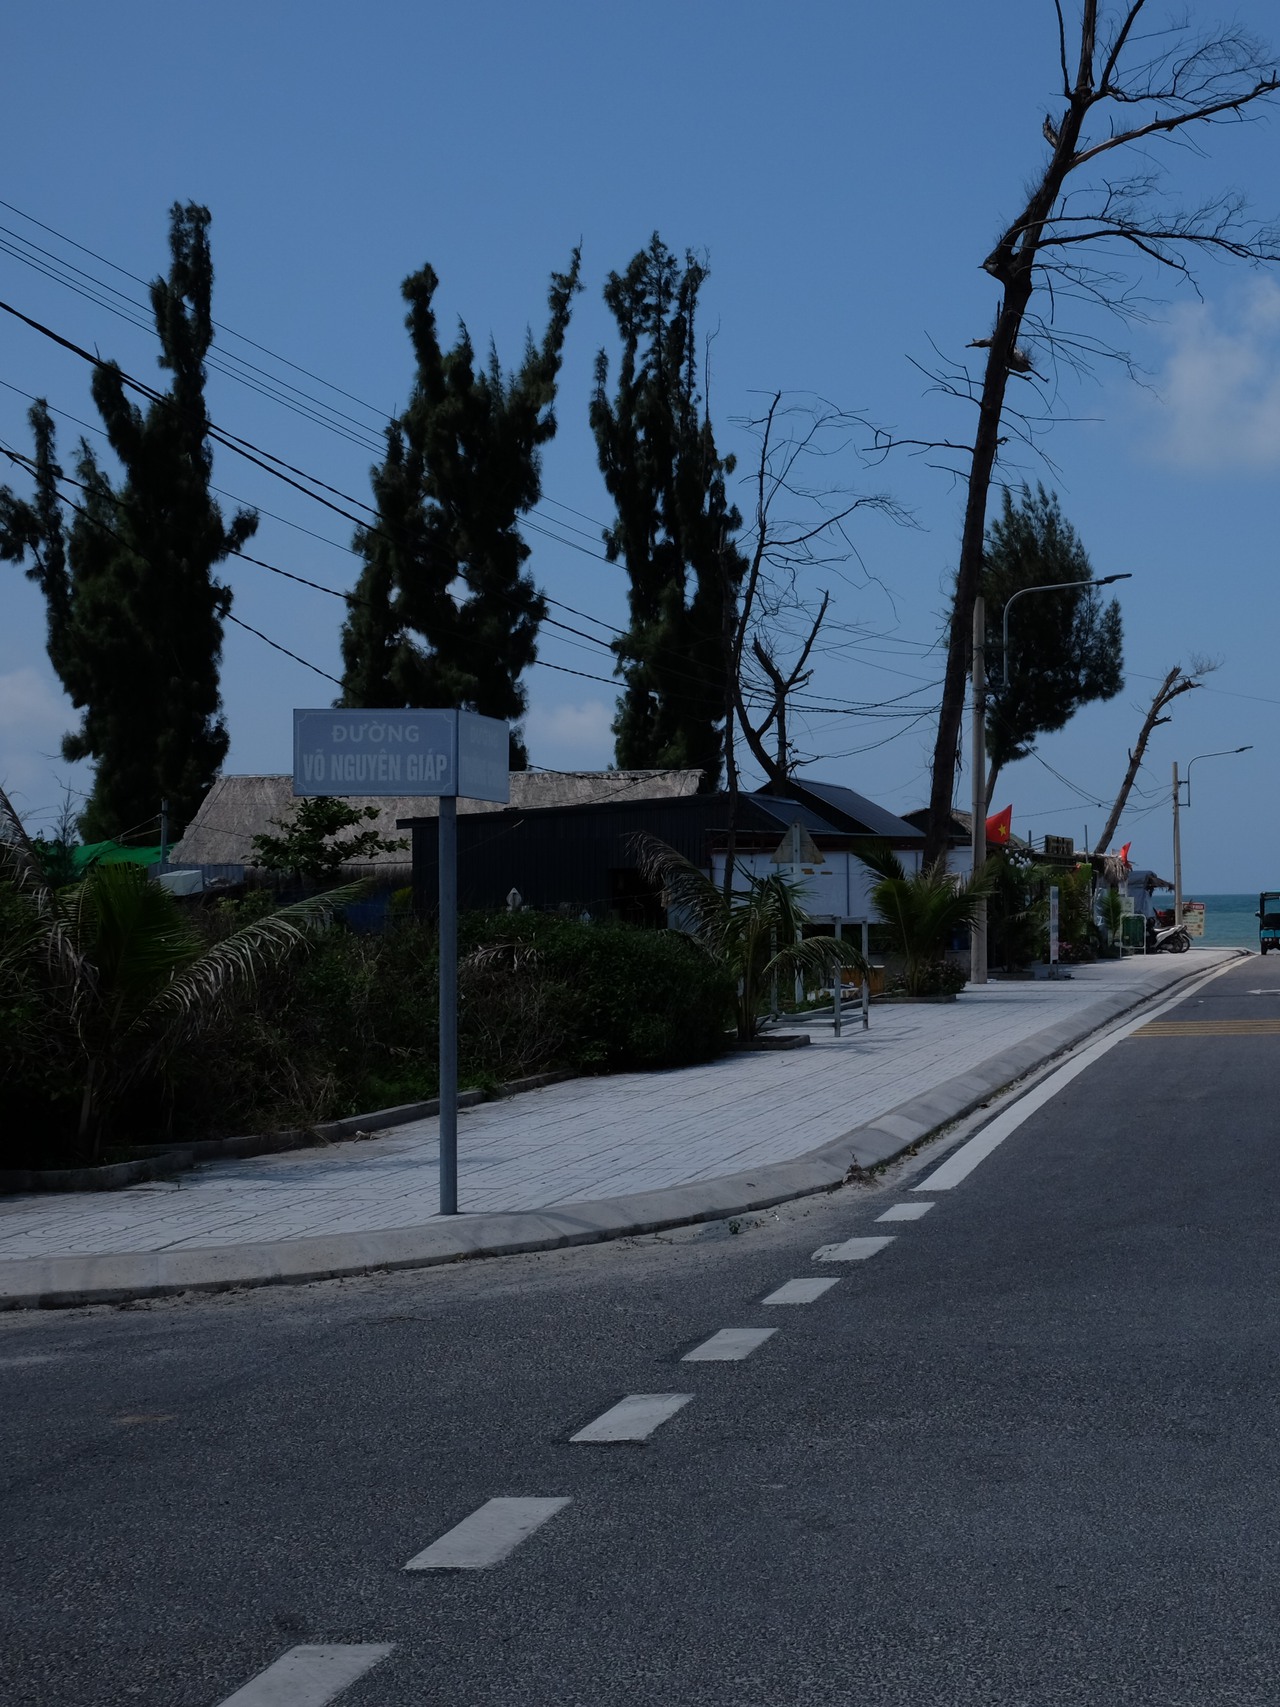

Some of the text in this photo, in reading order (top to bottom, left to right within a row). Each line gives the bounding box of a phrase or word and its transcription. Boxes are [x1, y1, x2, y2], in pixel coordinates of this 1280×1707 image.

[331, 720, 419, 742] ĐƯỜNG
[303, 747, 325, 782] VÕ
[331, 747, 401, 782] NGUYÊN
[407, 747, 448, 782] GIÁP
